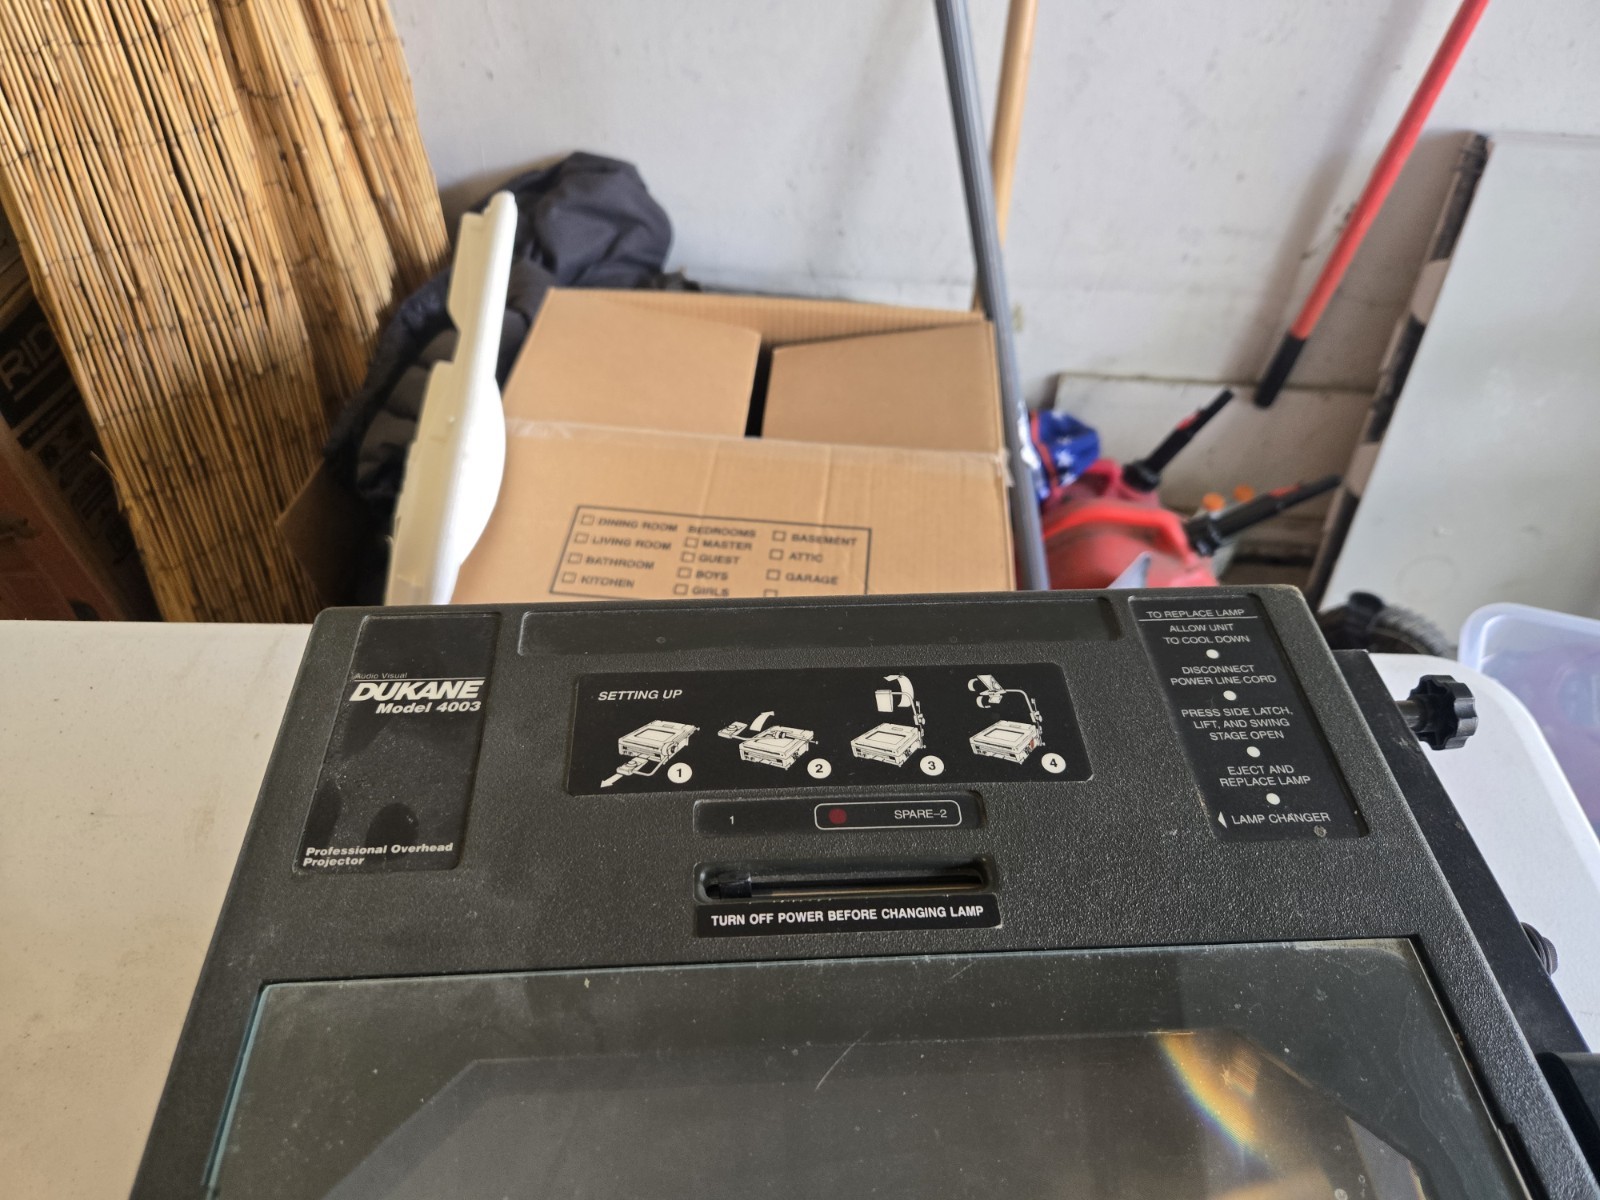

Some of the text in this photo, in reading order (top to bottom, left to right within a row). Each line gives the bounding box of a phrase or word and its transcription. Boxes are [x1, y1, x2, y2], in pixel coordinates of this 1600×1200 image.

[597, 517, 678, 532] DINING ROOM
[687, 525, 757, 538] BEDROOMS
[592, 536, 672, 551] LIVING ROOM
[702, 540, 753, 551] MASTER
[791, 533, 858, 547] BASEMENT
[585, 555, 655, 570] BATHROOM
[699, 554, 741, 565] GUEST
[788, 552, 824, 564] ATTIC
[580, 575, 635, 588] KITCHEN
[695, 571, 729, 581] BOYS
[785, 572, 839, 586] GARAGE
[692, 587, 730, 598] GIRLS
[1146, 609, 1245, 619] TO REPLACE LAMP
[1169, 623, 1234, 632] ALLOW UNIT
[1181, 636, 1213, 644] COOL
[1215, 635, 1250, 643] DOWN
[1181, 664, 1255, 674] DISCONNECT
[1170, 674, 1277, 686] POWER LINE CORD
[350, 679, 485, 702] DUKANE
[598, 689, 683, 702] SETTING UP
[375, 701, 482, 714] Model 4003
[1181, 708, 1221, 717] PRESS
[1223, 707, 1250, 716] SIDE
[1193, 718, 1290, 730] LIFT, AND SWING
[1209, 730, 1284, 741] STAGE OPEN
[1227, 765, 1294, 775] EJECT AND
[1219, 775, 1311, 787] REPLACE LAMP
[894, 808, 948, 820] SPARE-2
[1231, 812, 1331, 825] LAMP CHANGER
[305, 842, 454, 856] Professional Overhead
[302, 856, 365, 868] Projector
[711, 905, 984, 926] TURN OFF POWER BEFORE CHANGING LAMP
